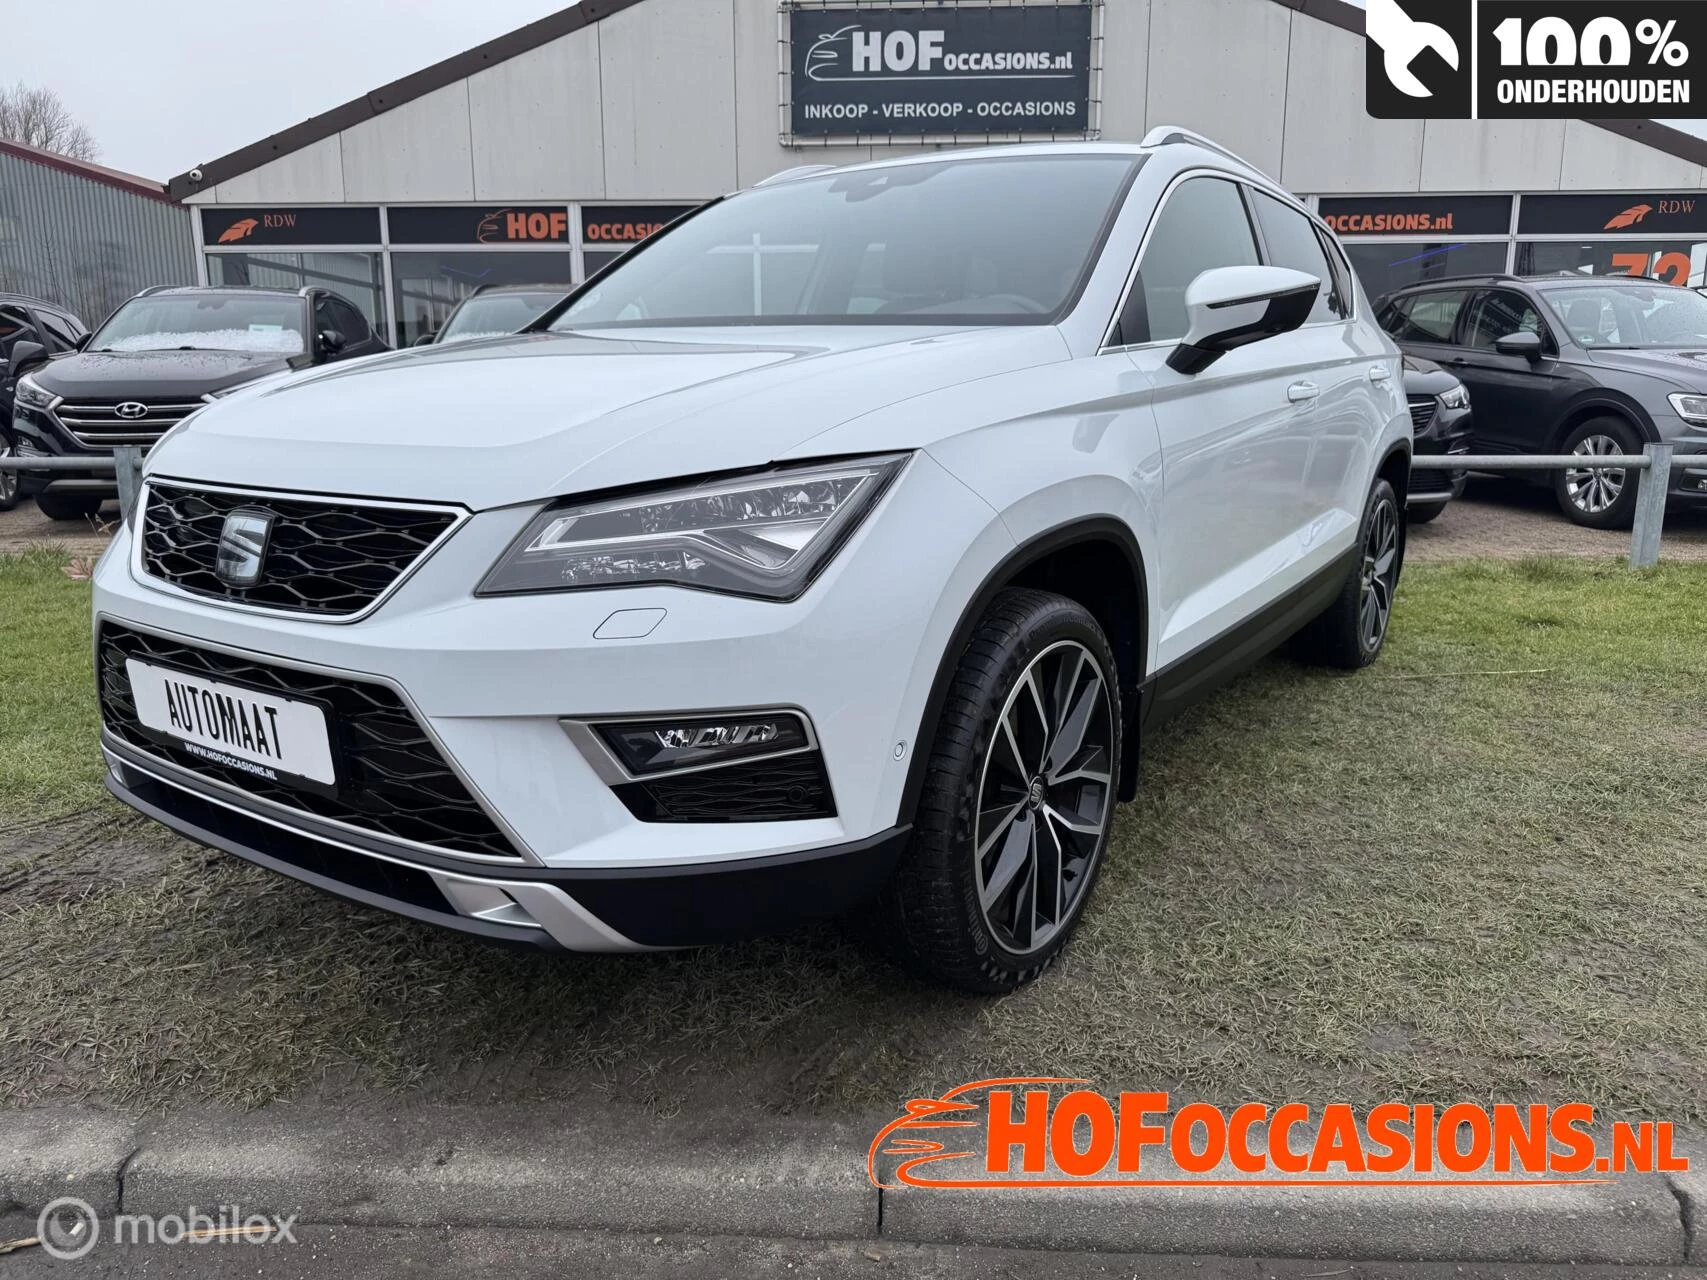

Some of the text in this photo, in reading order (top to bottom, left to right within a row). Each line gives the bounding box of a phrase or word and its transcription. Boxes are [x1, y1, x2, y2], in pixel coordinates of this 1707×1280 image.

[804, 103, 868, 119] INKOOP
[882, 102, 963, 118] VERKOOP
[977, 101, 1076, 117] OCCASIONS
[1658, 199, 1696, 214] RDW
[264, 214, 297, 229] RDW
[507, 212, 568, 240] HOF
[1324, 212, 1453, 232] OCCASIONS.nl
[164, 678, 282, 760] AUTOMAAT
[184, 742, 278, 781] WWW.HOFOCCASIONS.NL
